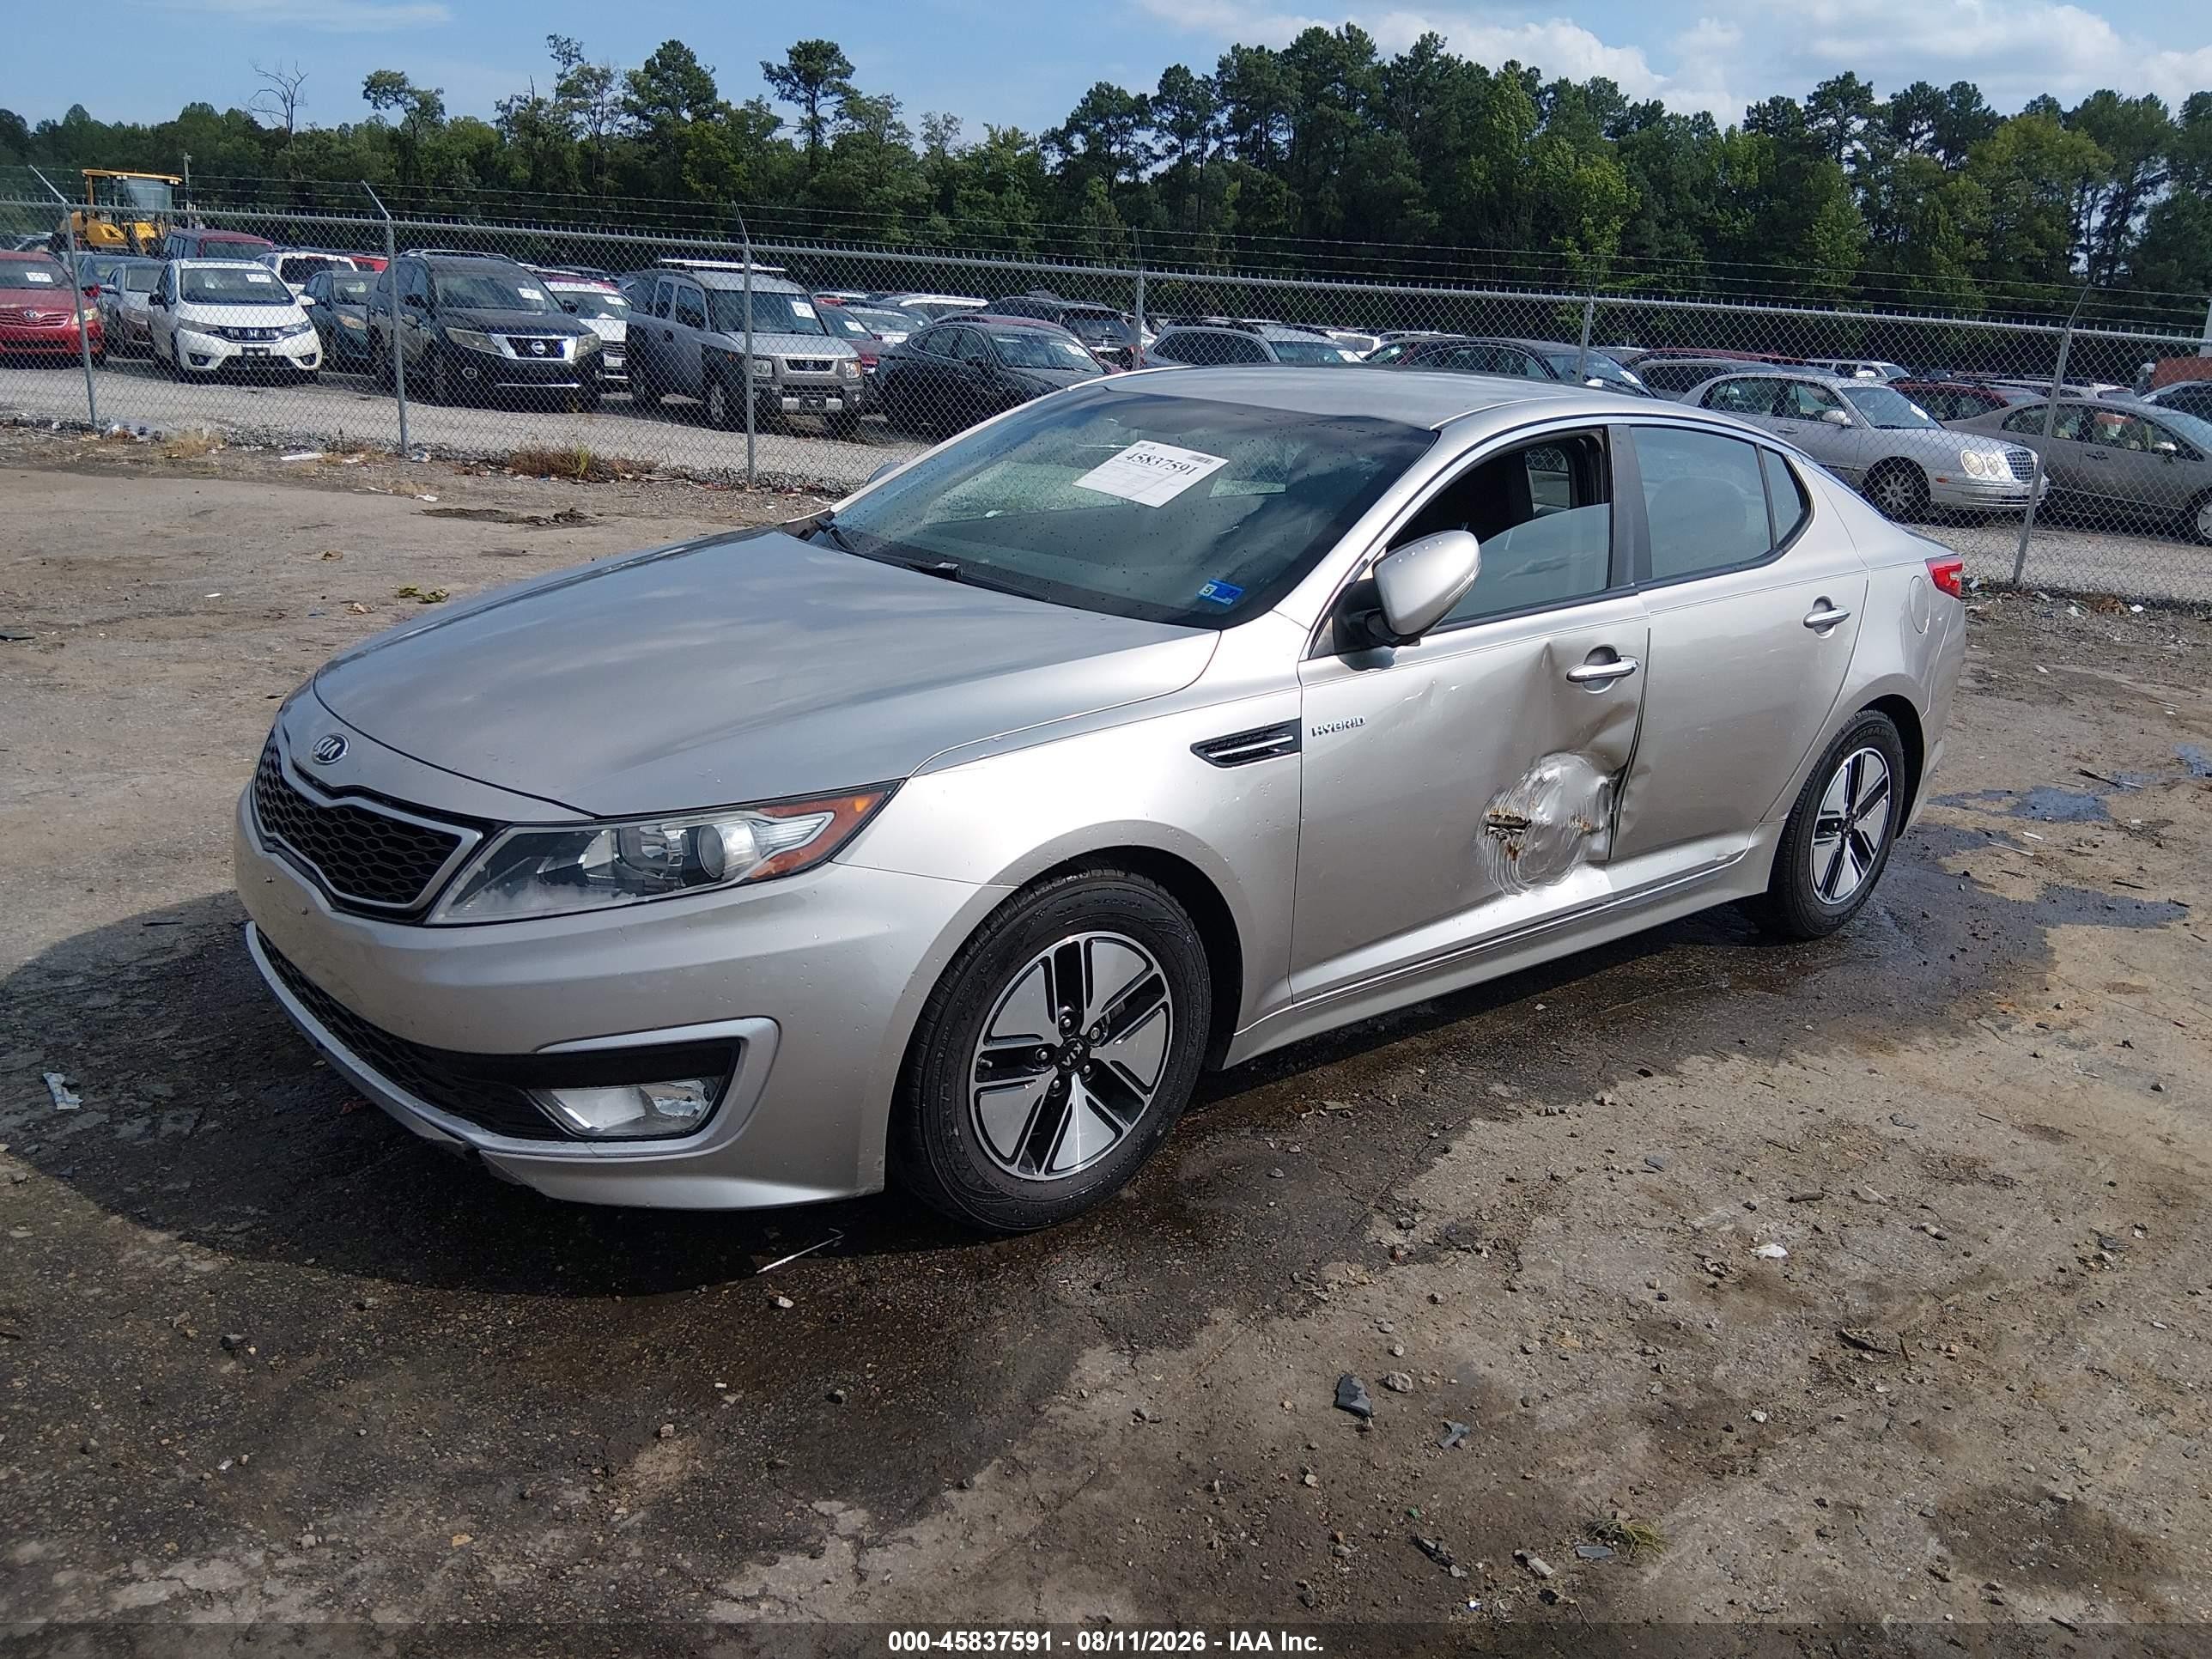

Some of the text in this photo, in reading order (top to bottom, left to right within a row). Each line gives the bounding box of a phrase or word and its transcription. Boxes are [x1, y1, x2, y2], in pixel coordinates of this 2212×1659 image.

[1126, 452, 1199, 476] 45837591
[1311, 716, 1366, 738] HYBRID
[314, 736, 342, 760] KIA
[1060, 1042, 1084, 1066] KIA
